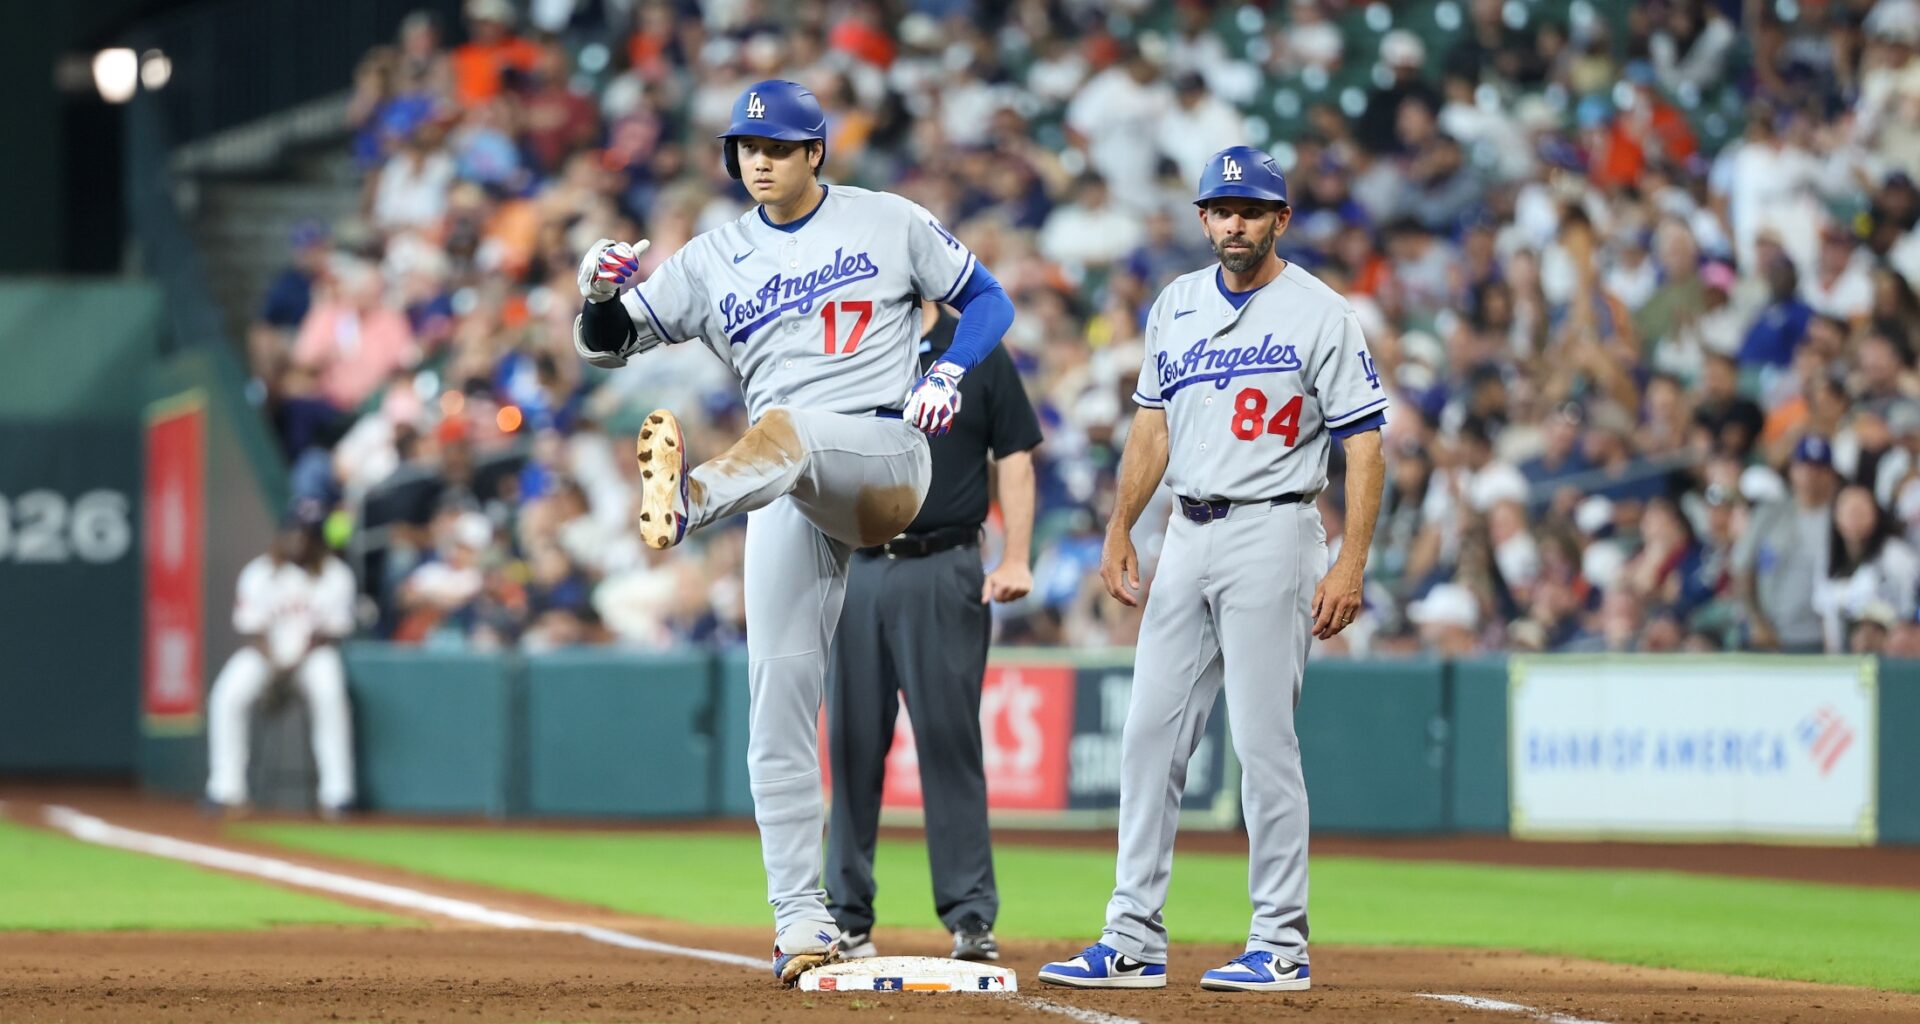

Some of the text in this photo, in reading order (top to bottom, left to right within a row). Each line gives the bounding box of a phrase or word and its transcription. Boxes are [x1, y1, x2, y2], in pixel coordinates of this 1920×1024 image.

[747, 92, 765, 118] LA
[1222, 155, 1242, 181] LA
[720, 247, 878, 334] Los Angeles
[820, 300, 873, 354] 17
[1157, 333, 1302, 390] Los Angeles
[1357, 350, 1380, 389] LA
[1230, 387, 1304, 448] 84
[0, 488, 131, 564] 26
[1527, 730, 1787, 773] BANK OF AMERICA
